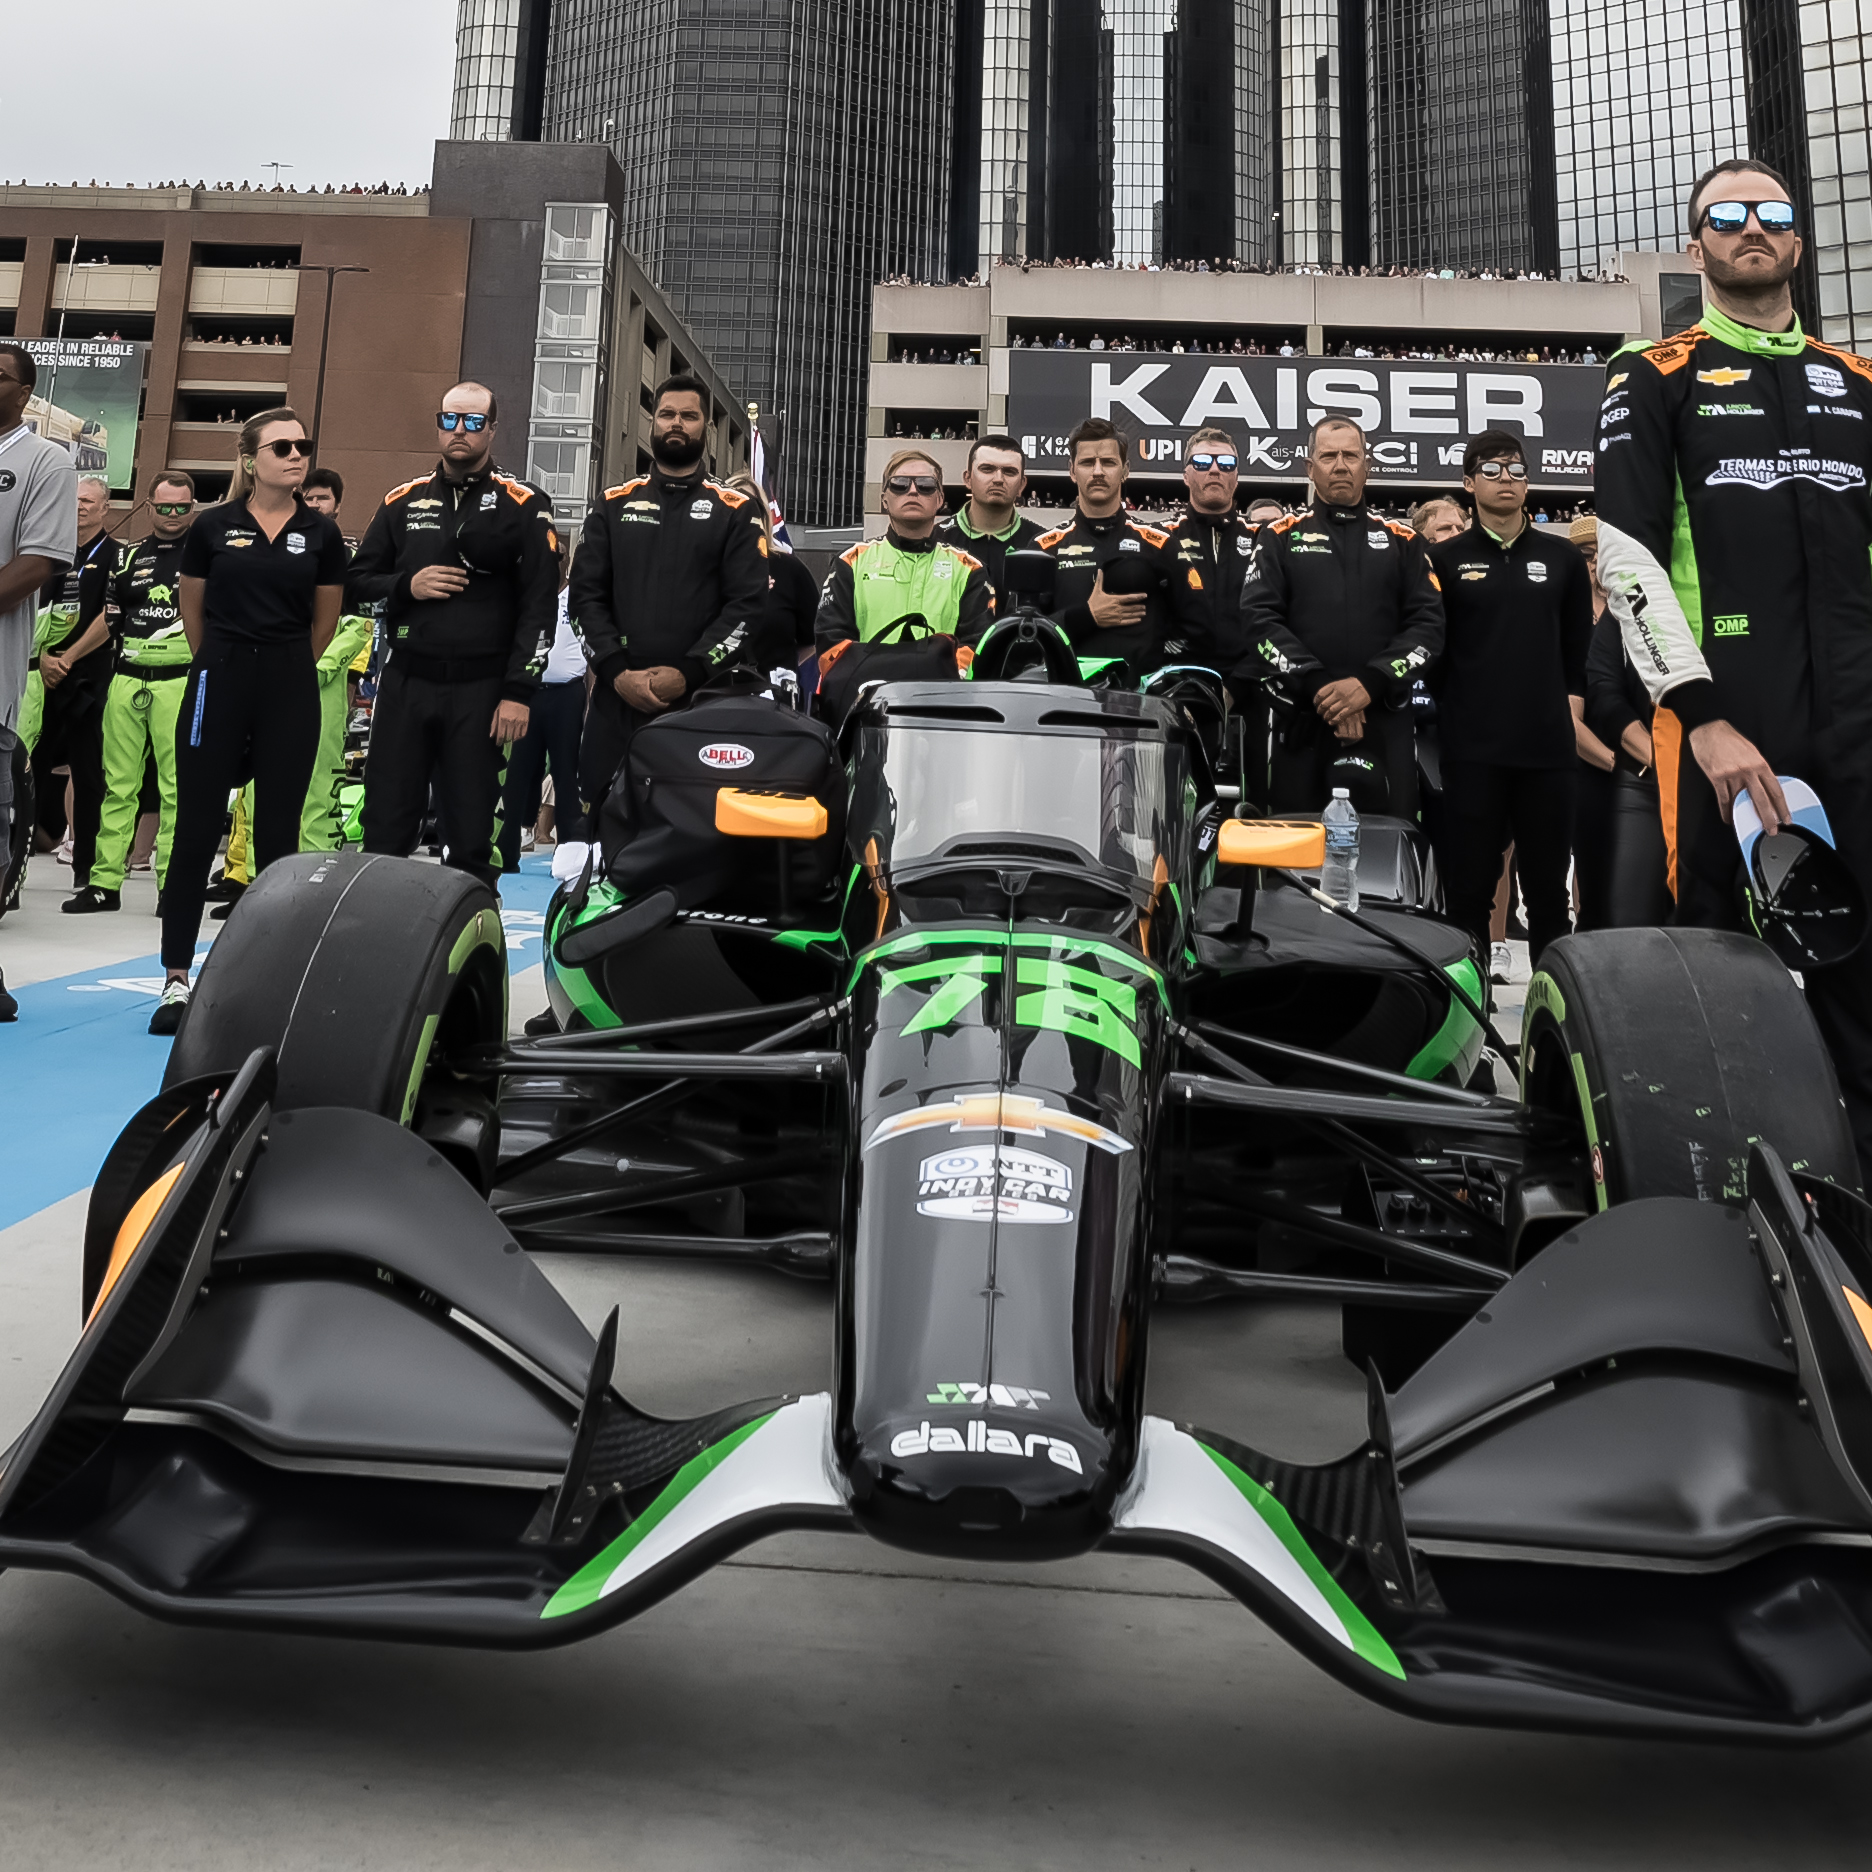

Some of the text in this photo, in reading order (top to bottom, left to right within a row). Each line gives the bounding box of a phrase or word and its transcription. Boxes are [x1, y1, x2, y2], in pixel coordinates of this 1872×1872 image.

[21, 340, 64, 354] LEADER
[66, 342, 78, 354] IN
[81, 343, 134, 356] RELIABLE
[1651, 347, 1679, 363] OMP
[58, 355, 91, 367] SINCE
[93, 356, 121, 368] 1950
[1091, 361, 1544, 437] KAISER
[1381, 466, 1418, 474] CONTROLS
[1719, 458, 1775, 472] TERMAS
[1799, 459, 1820, 471] RIO
[1822, 459, 1863, 479] HONDO
[138, 607, 178, 619] askROI
[1714, 618, 1749, 633] OMP
[1635, 615, 1671, 677] HOLLINGER
[708, 749, 746, 761] BELL
[880, 955, 1142, 1071] 78
[989, 1157, 1059, 1179] NTT
[918, 1176, 1072, 1203] INDYCAR
[890, 1420, 1084, 1476] dallara
